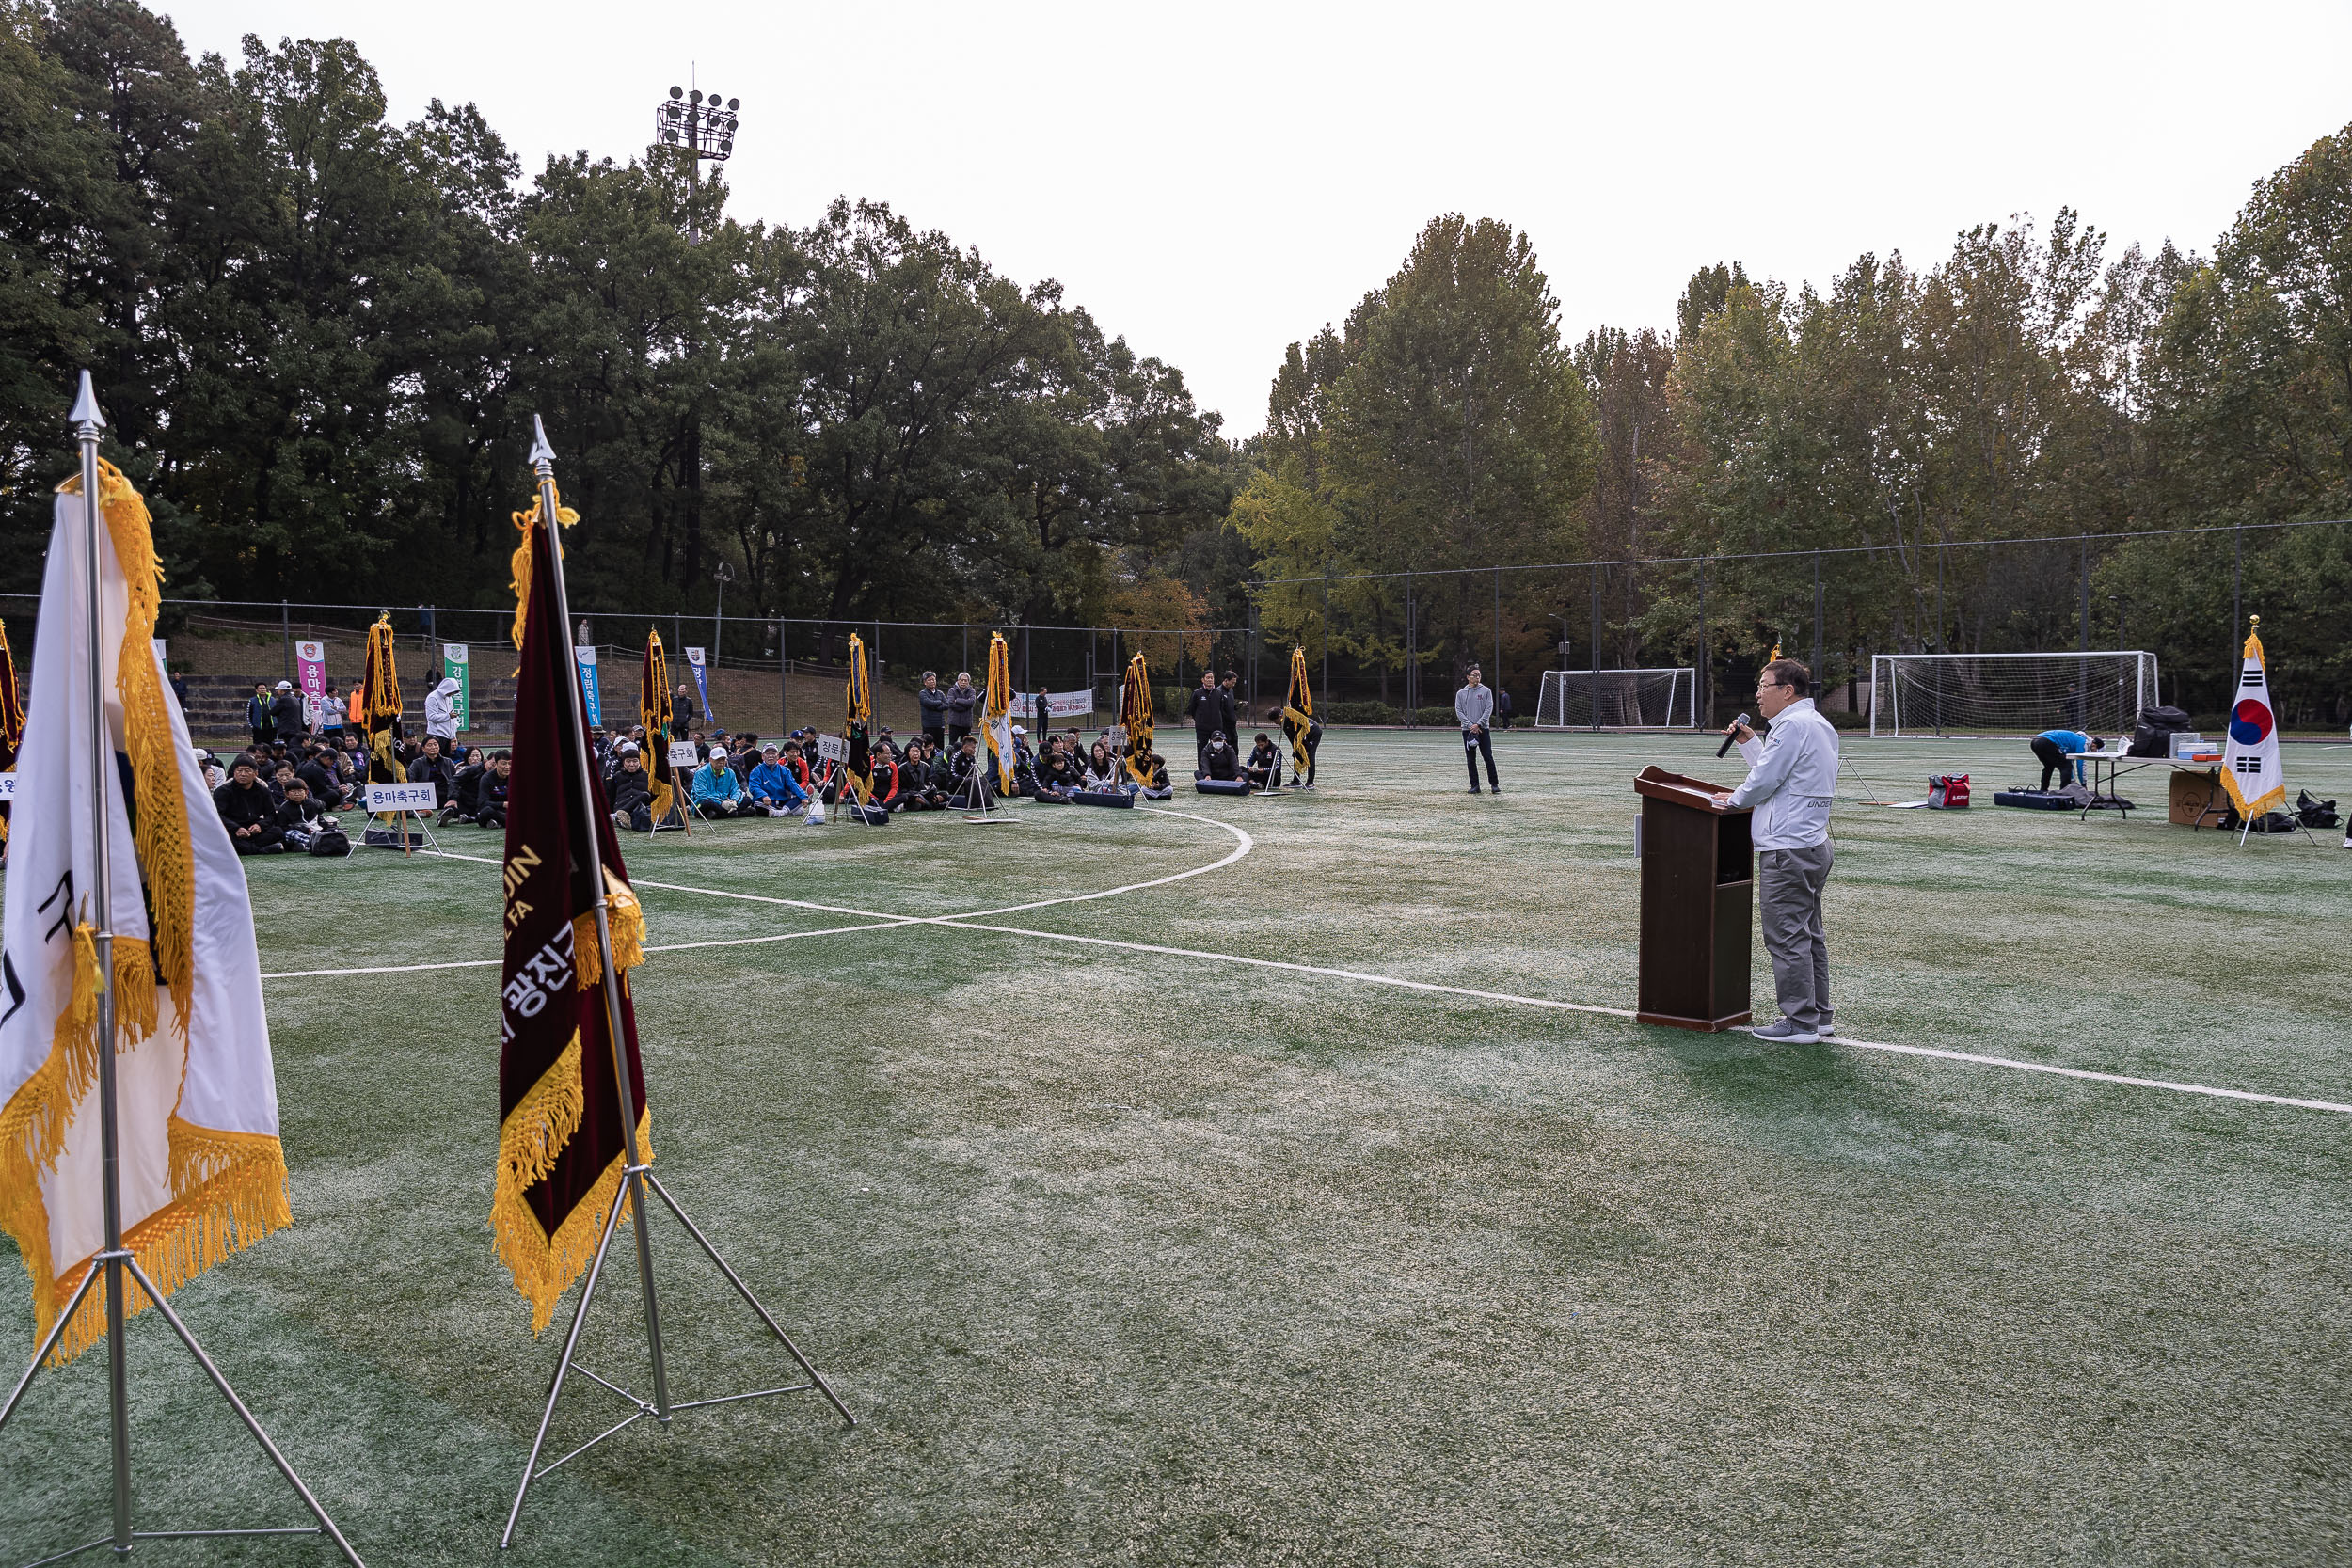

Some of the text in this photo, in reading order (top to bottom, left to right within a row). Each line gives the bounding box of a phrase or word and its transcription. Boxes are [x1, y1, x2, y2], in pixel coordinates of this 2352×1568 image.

[581, 667, 598, 725] 정립축구회
[667, 748, 694, 760] 축구회
[373, 789, 431, 804] 용마축구회
[503, 844, 542, 901] JIN
[507, 899, 534, 927] FA
